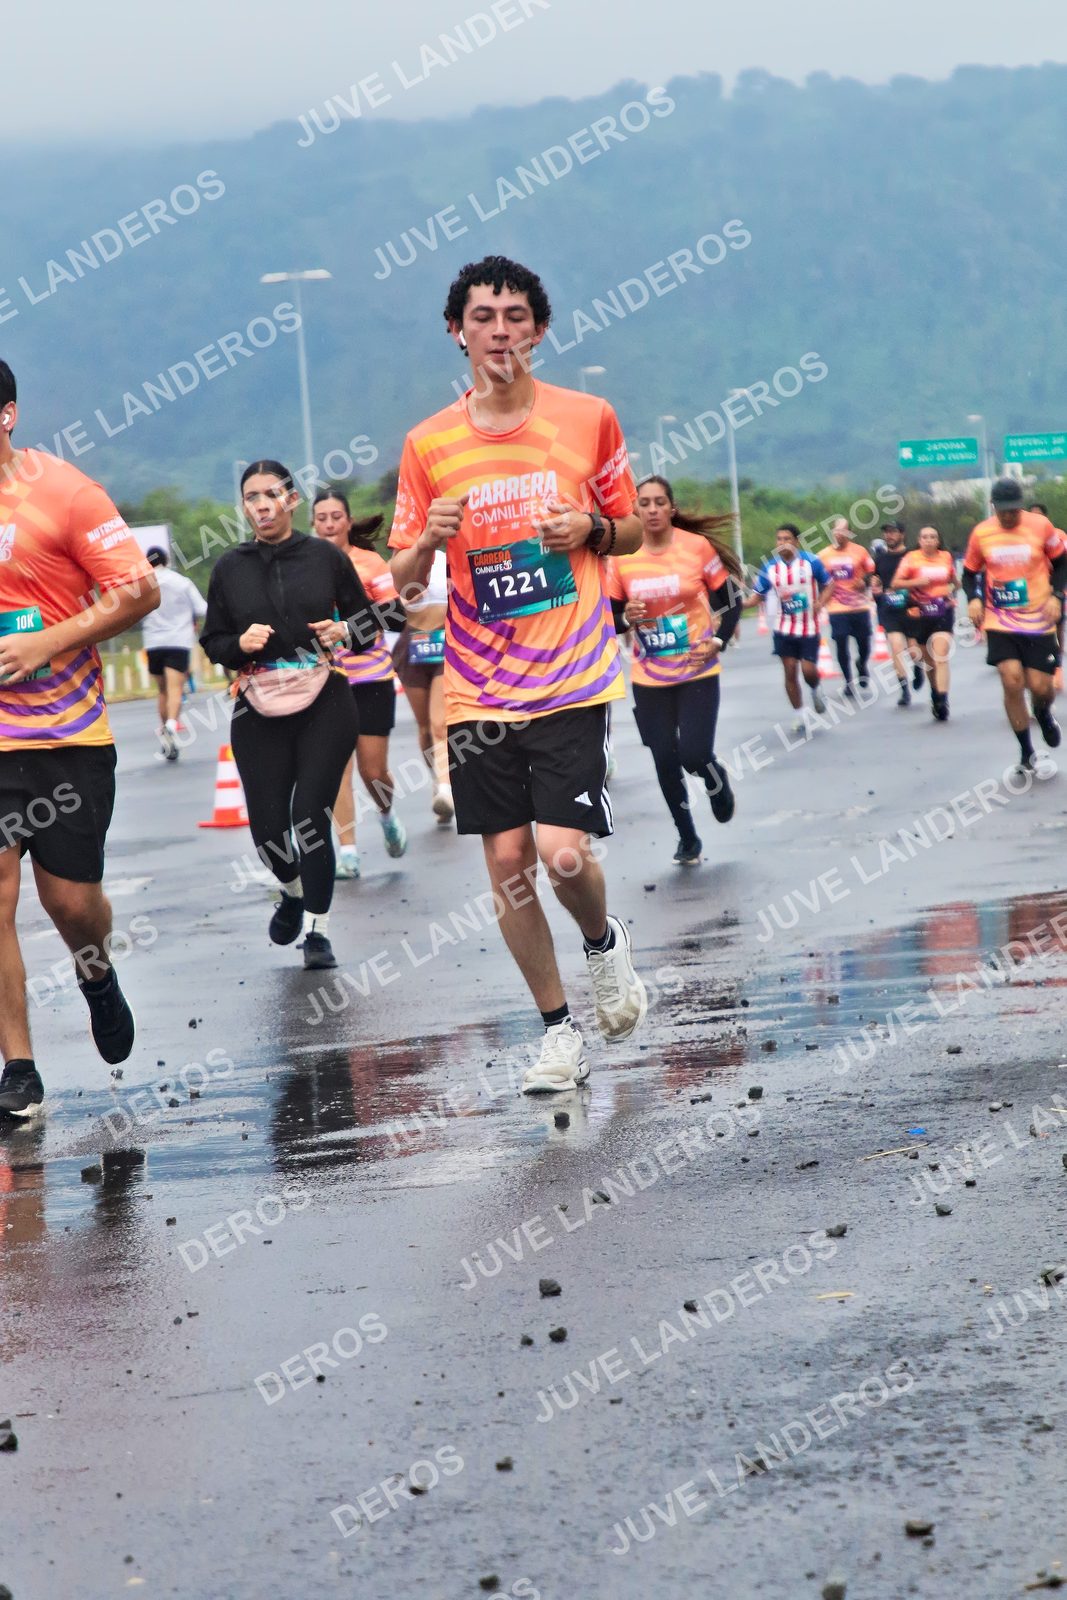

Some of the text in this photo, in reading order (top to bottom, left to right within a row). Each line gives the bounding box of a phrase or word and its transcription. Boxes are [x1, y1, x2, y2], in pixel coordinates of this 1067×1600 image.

[468, 470, 558, 510] CARRERA
[473, 550, 512, 566] CARRERA
[488, 567, 548, 599] 1221
[16, 613, 34, 631] 10K
[417, 643, 443, 655] 1617
